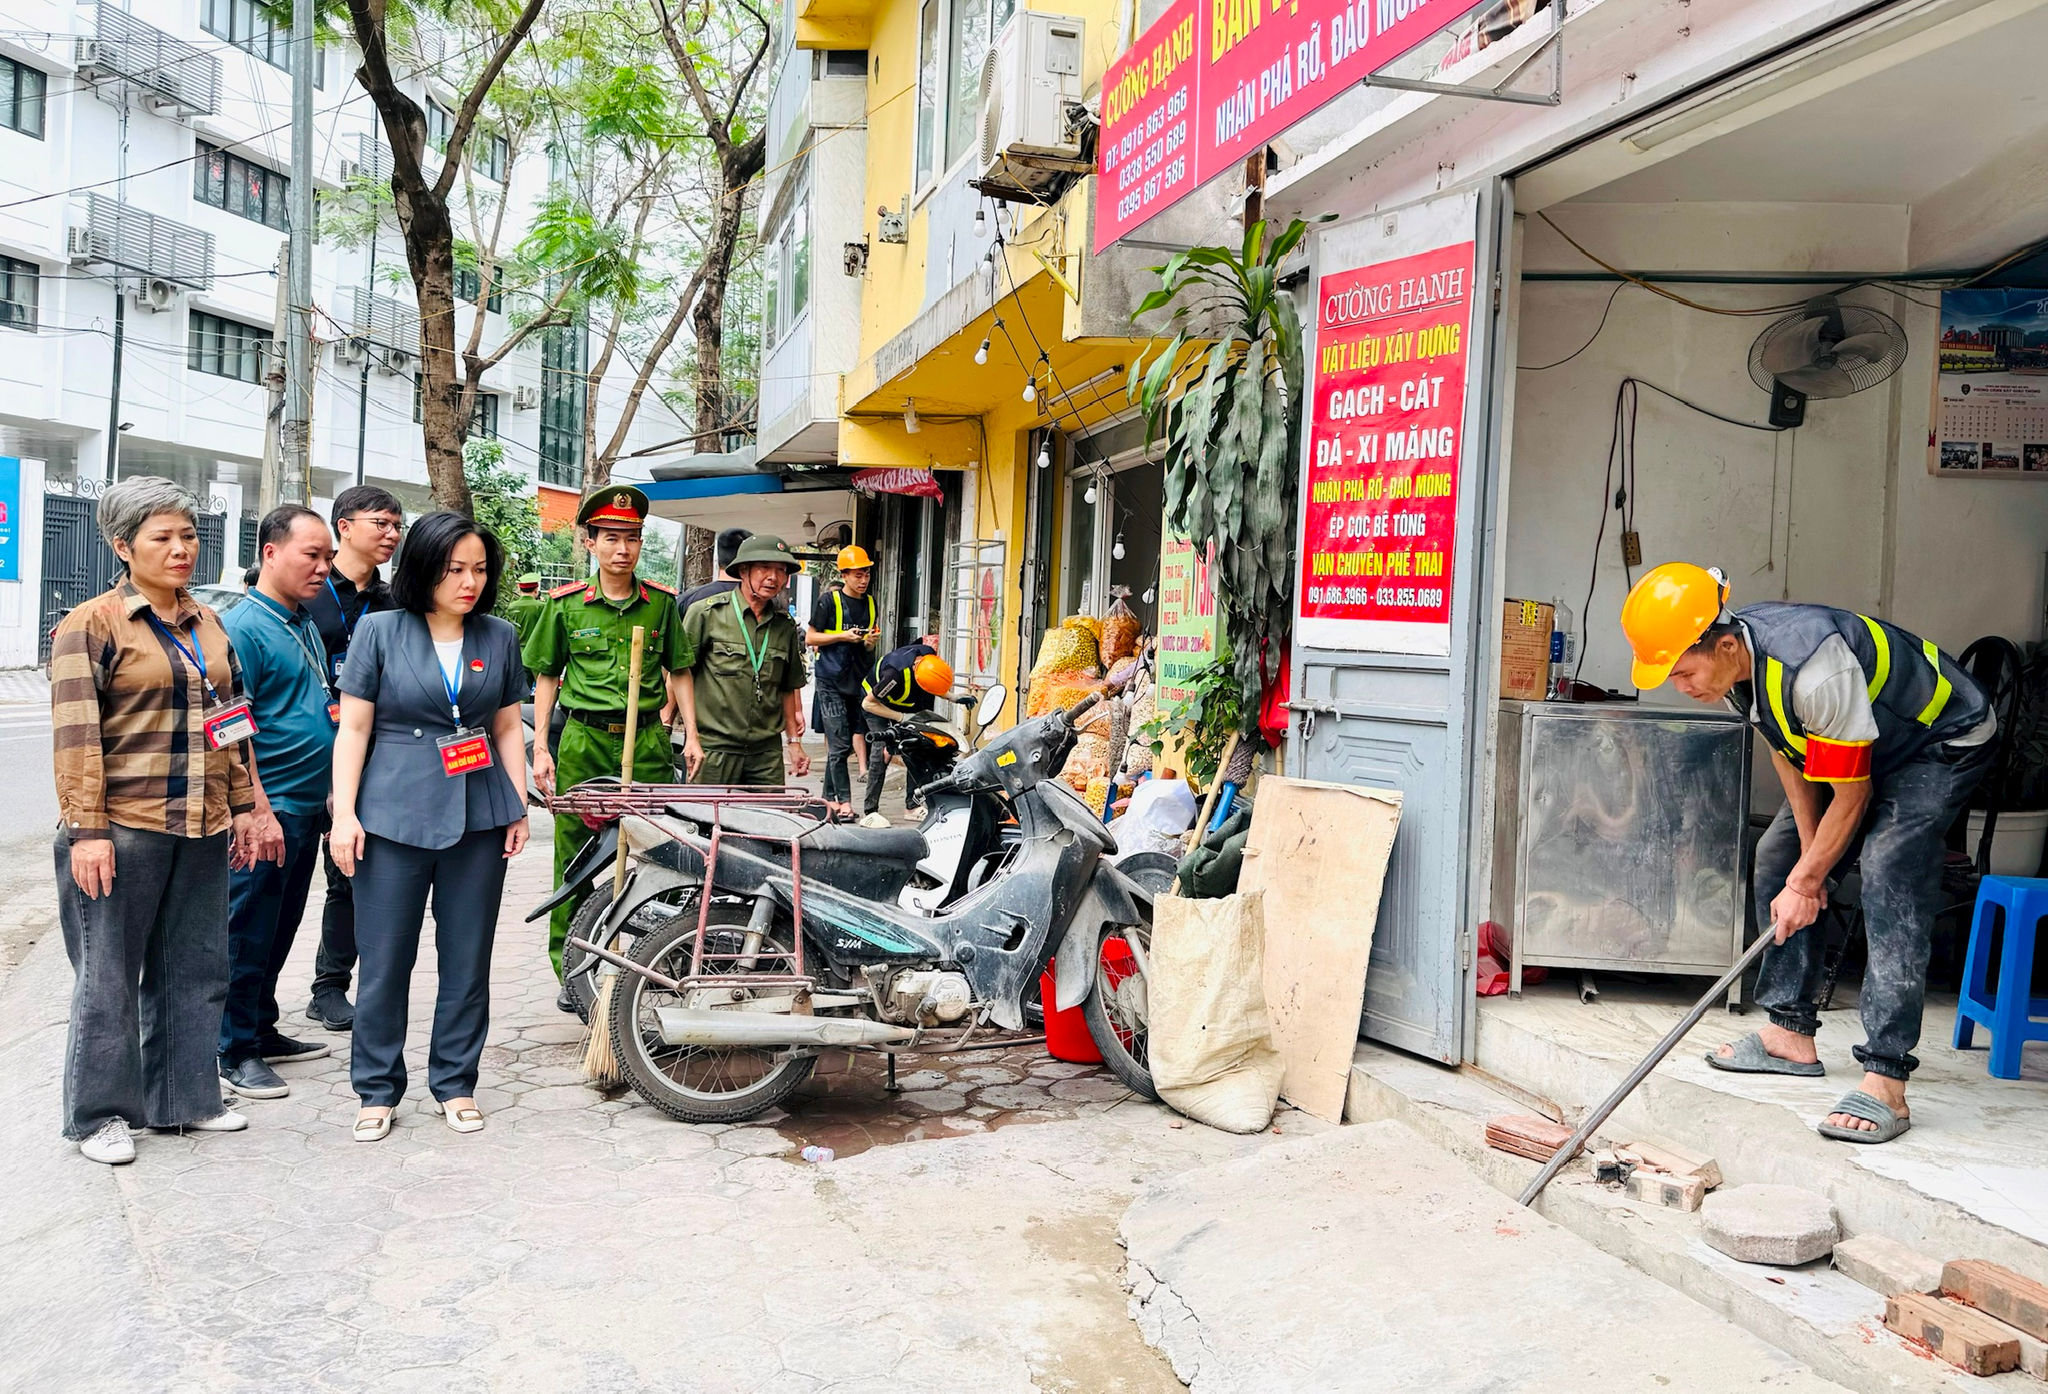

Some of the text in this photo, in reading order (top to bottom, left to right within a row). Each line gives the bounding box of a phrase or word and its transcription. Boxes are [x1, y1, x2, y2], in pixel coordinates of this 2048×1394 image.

[1106, 12, 1194, 129] CƯỜNG HẠNH
[1216, 79, 1256, 148] NHẬN
[1260, 43, 1292, 116] PHÁ
[1121, 122, 1144, 161] 0916
[1146, 104, 1165, 139] 863
[1167, 85, 1187, 122] 966
[1119, 119, 1187, 191] 0338 550 689
[1118, 154, 1185, 222] 0395 867 586
[1325, 281, 1393, 324] CƯỜNG
[1322, 322, 1461, 379] VẬT LIỆU XÂY DỰNG
[1329, 385, 1385, 424] GẠCH
[1400, 372, 1445, 412] CÁT
[1316, 432, 1342, 467] ĐÁ
[1357, 435, 1378, 464] XI
[1385, 424, 1453, 462] MĂNG
[1313, 477, 1341, 508] NHẬN
[1343, 474, 1364, 502] PHÁ
[1389, 472, 1412, 499] ĐÀO
[1415, 469, 1451, 498] MÓNG
[1329, 509, 1426, 543] ÉP CỌC BÊ TÔNG
[1312, 542, 1443, 581] VẬN CHUYỂN PHẾ THẢI
[1308, 586, 1368, 605] 091.686.3966
[1376, 587, 1443, 609] 033.855.0689
[836, 938, 862, 949] SYM
